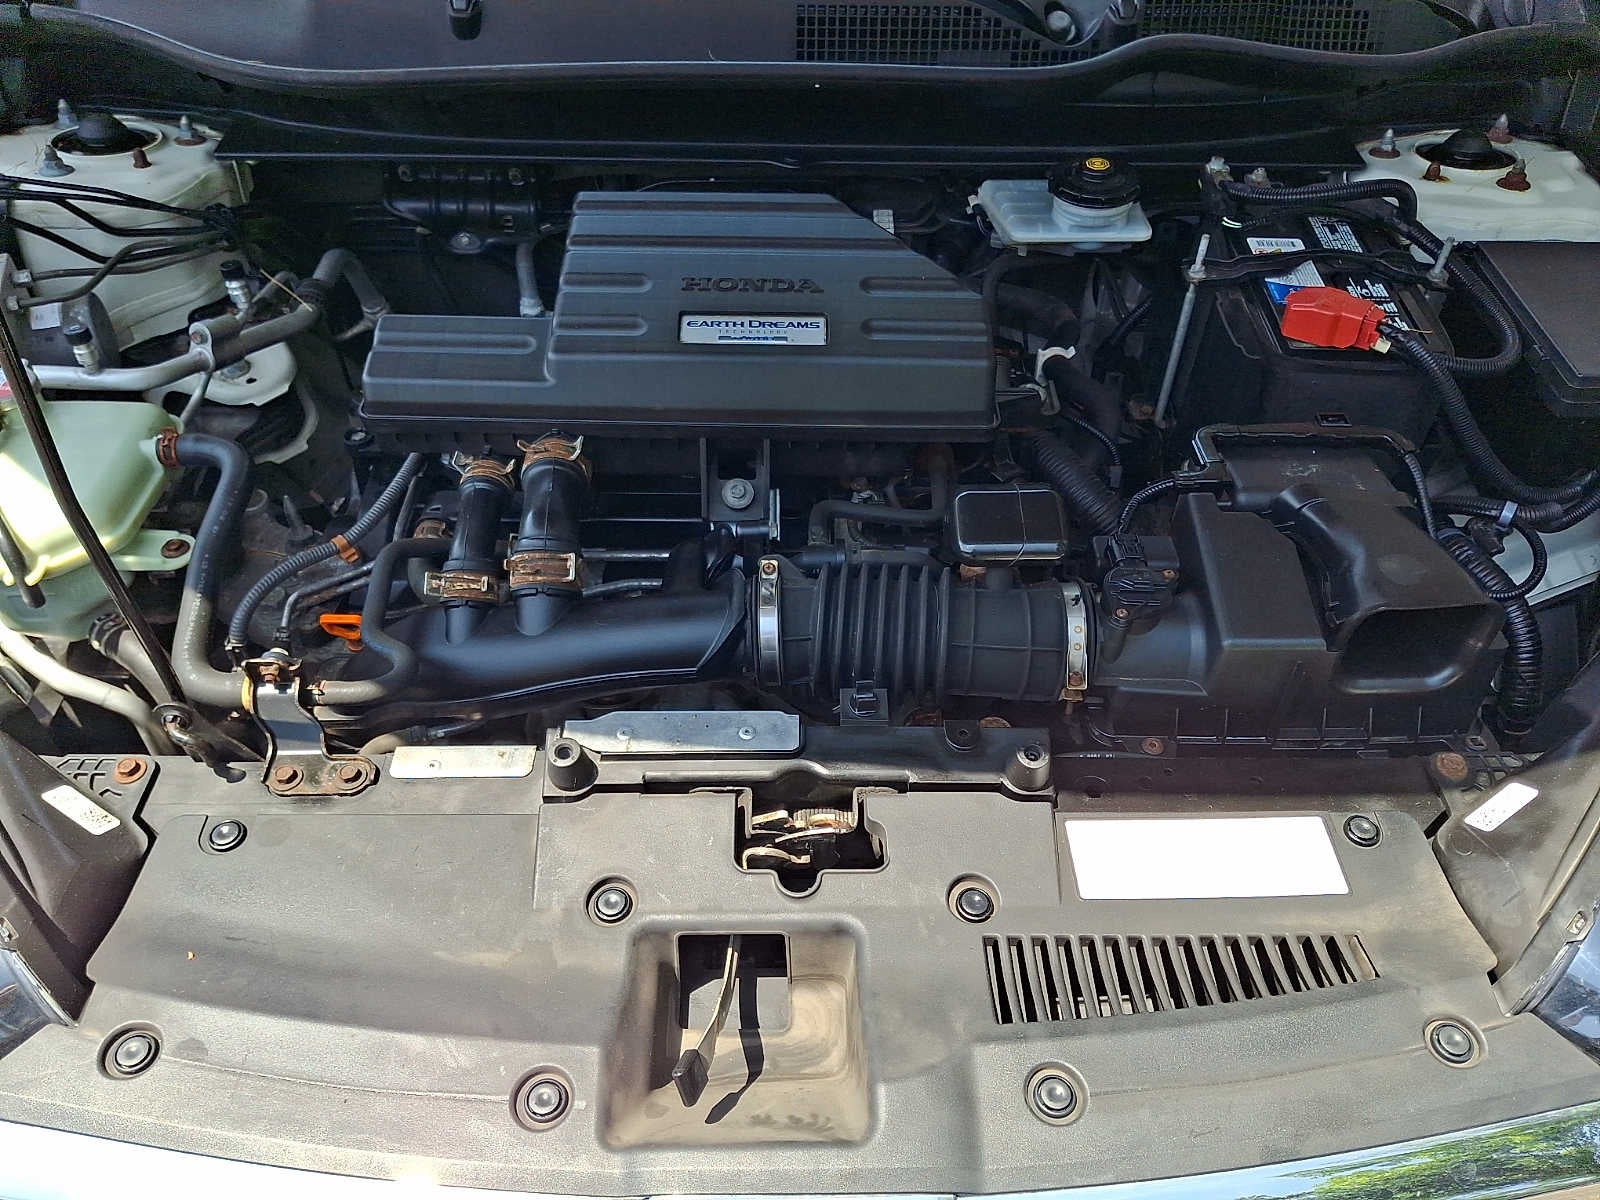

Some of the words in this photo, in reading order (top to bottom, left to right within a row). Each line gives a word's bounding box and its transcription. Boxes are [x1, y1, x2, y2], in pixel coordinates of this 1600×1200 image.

[681, 277, 825, 294] HONDA
[686, 320, 745, 328] EARTH
[748, 319, 821, 329] DREAMS
